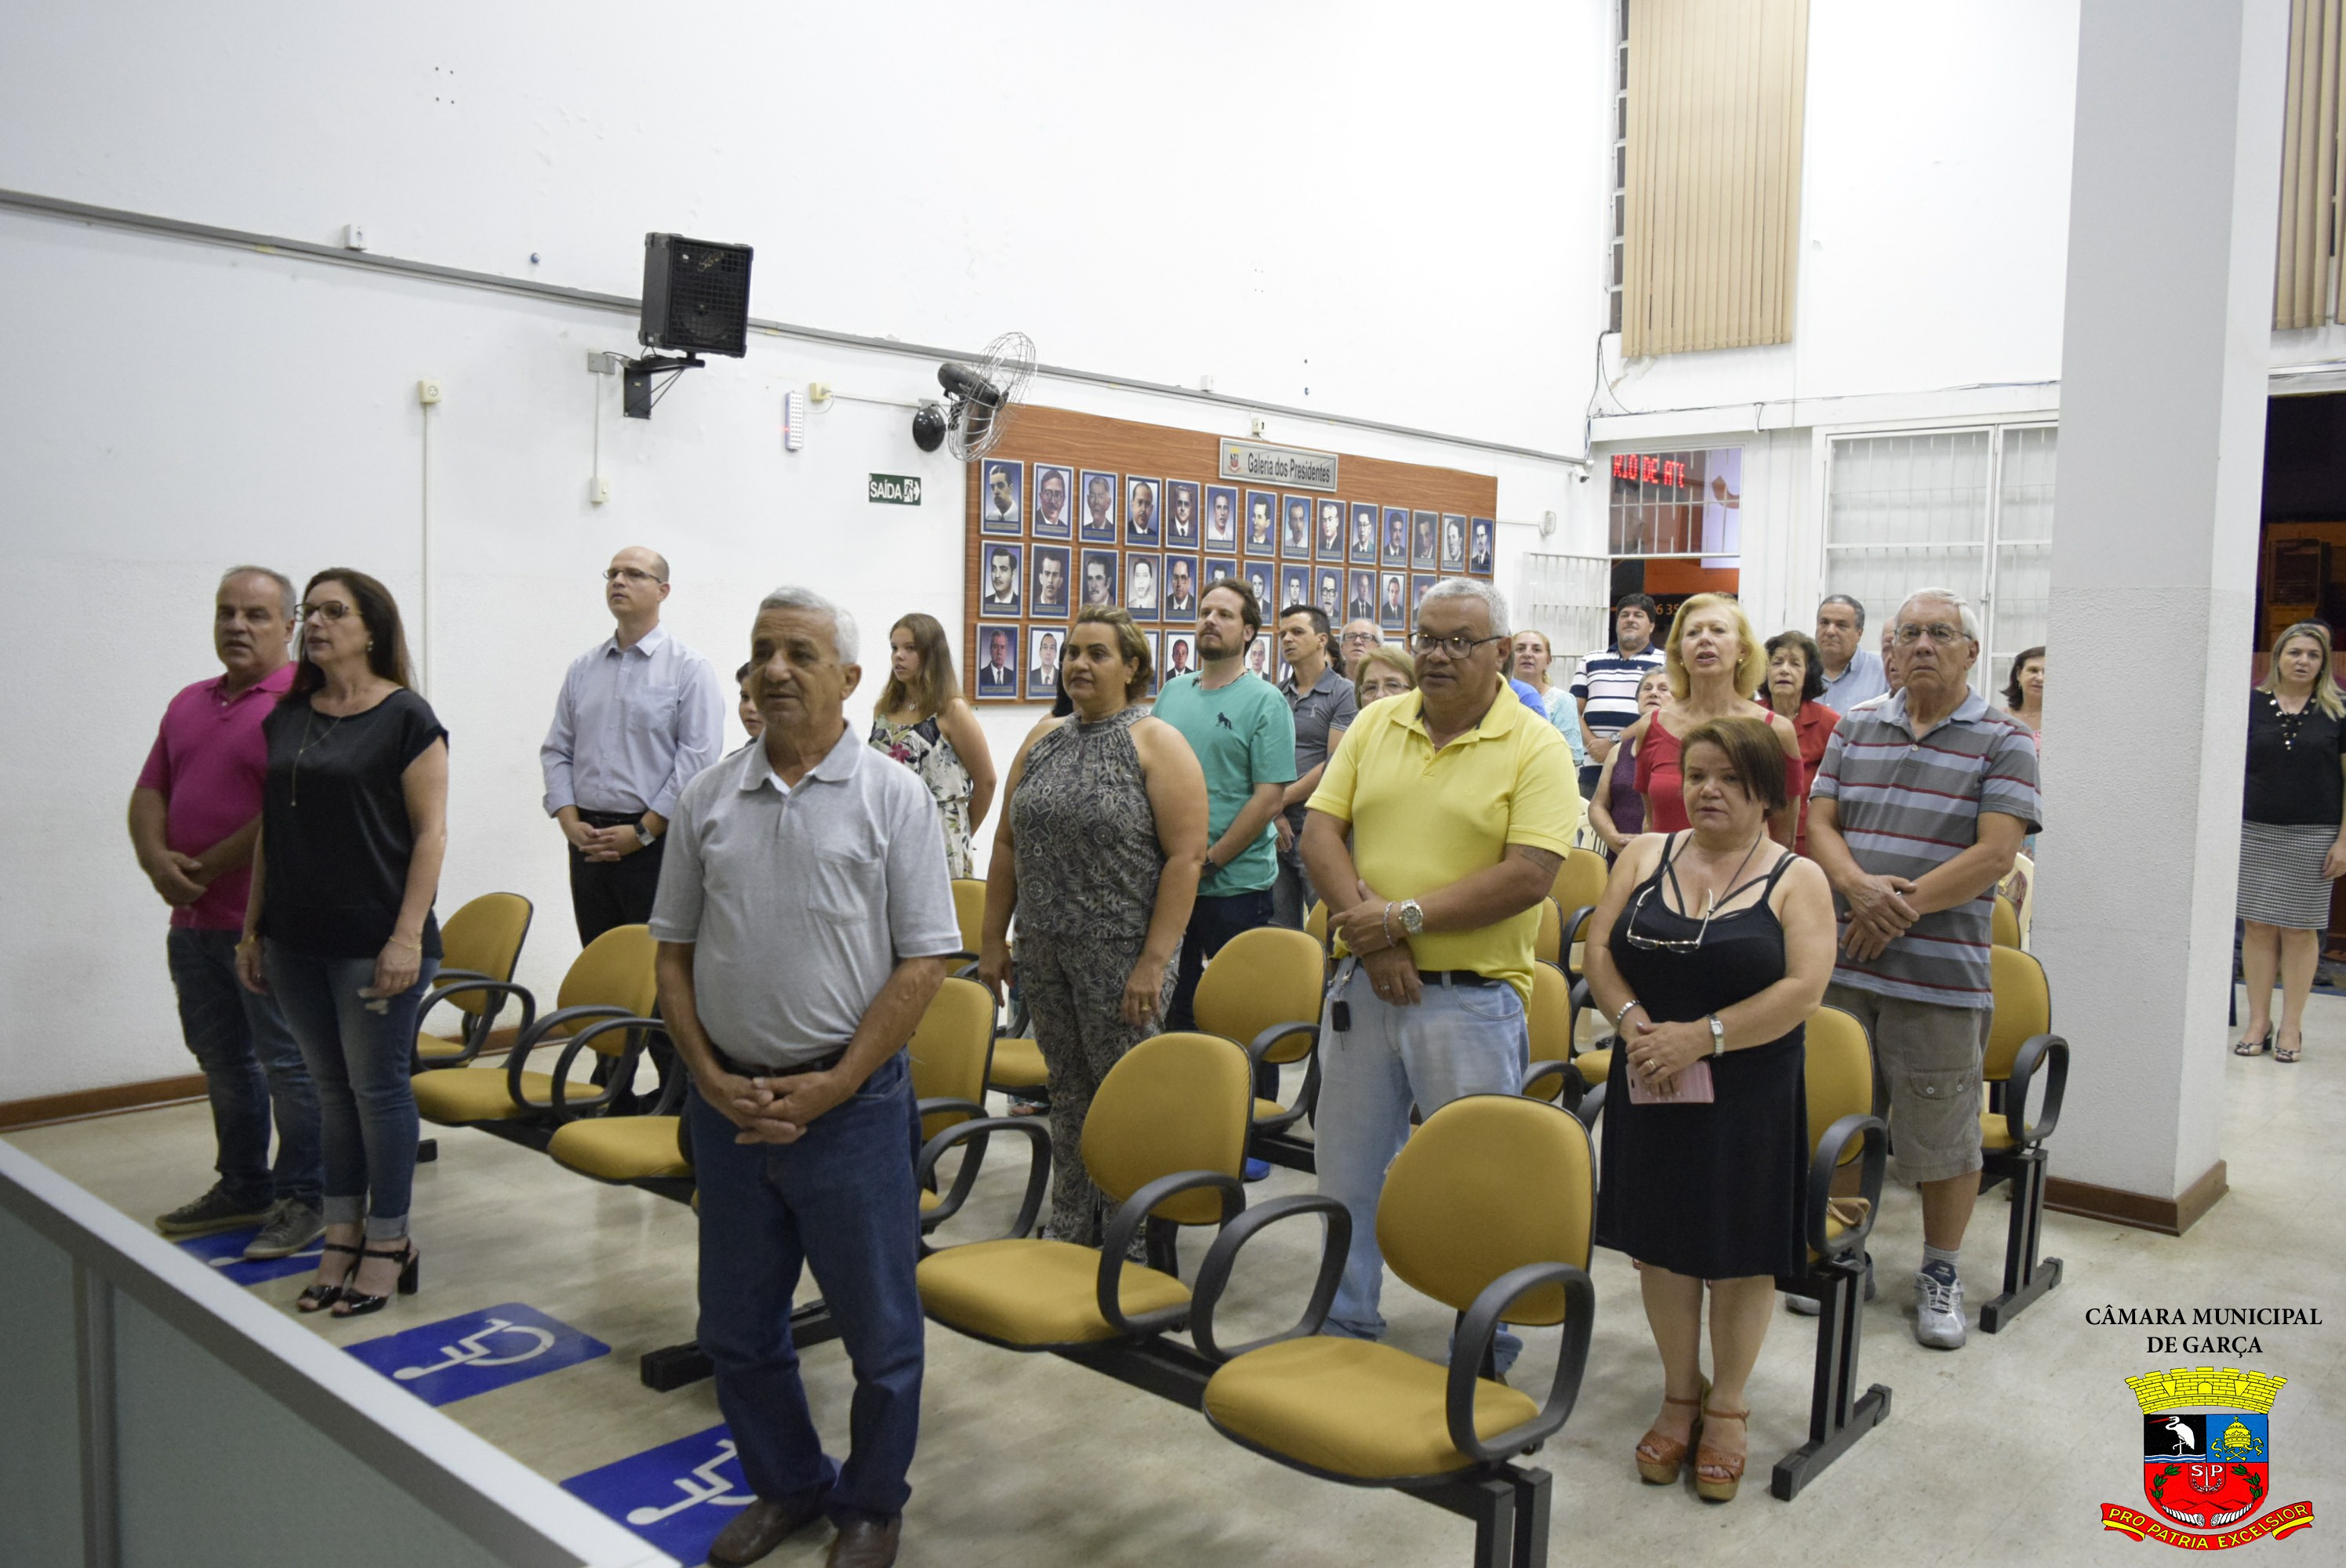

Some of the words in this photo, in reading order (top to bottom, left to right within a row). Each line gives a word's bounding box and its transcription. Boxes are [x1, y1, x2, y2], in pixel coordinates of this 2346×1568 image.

[1247, 452, 1273, 475] Galeria
[1275, 457, 1288, 477] dos
[1290, 459, 1331, 483] Presidentes
[870, 479, 902, 500] SAÍDA
